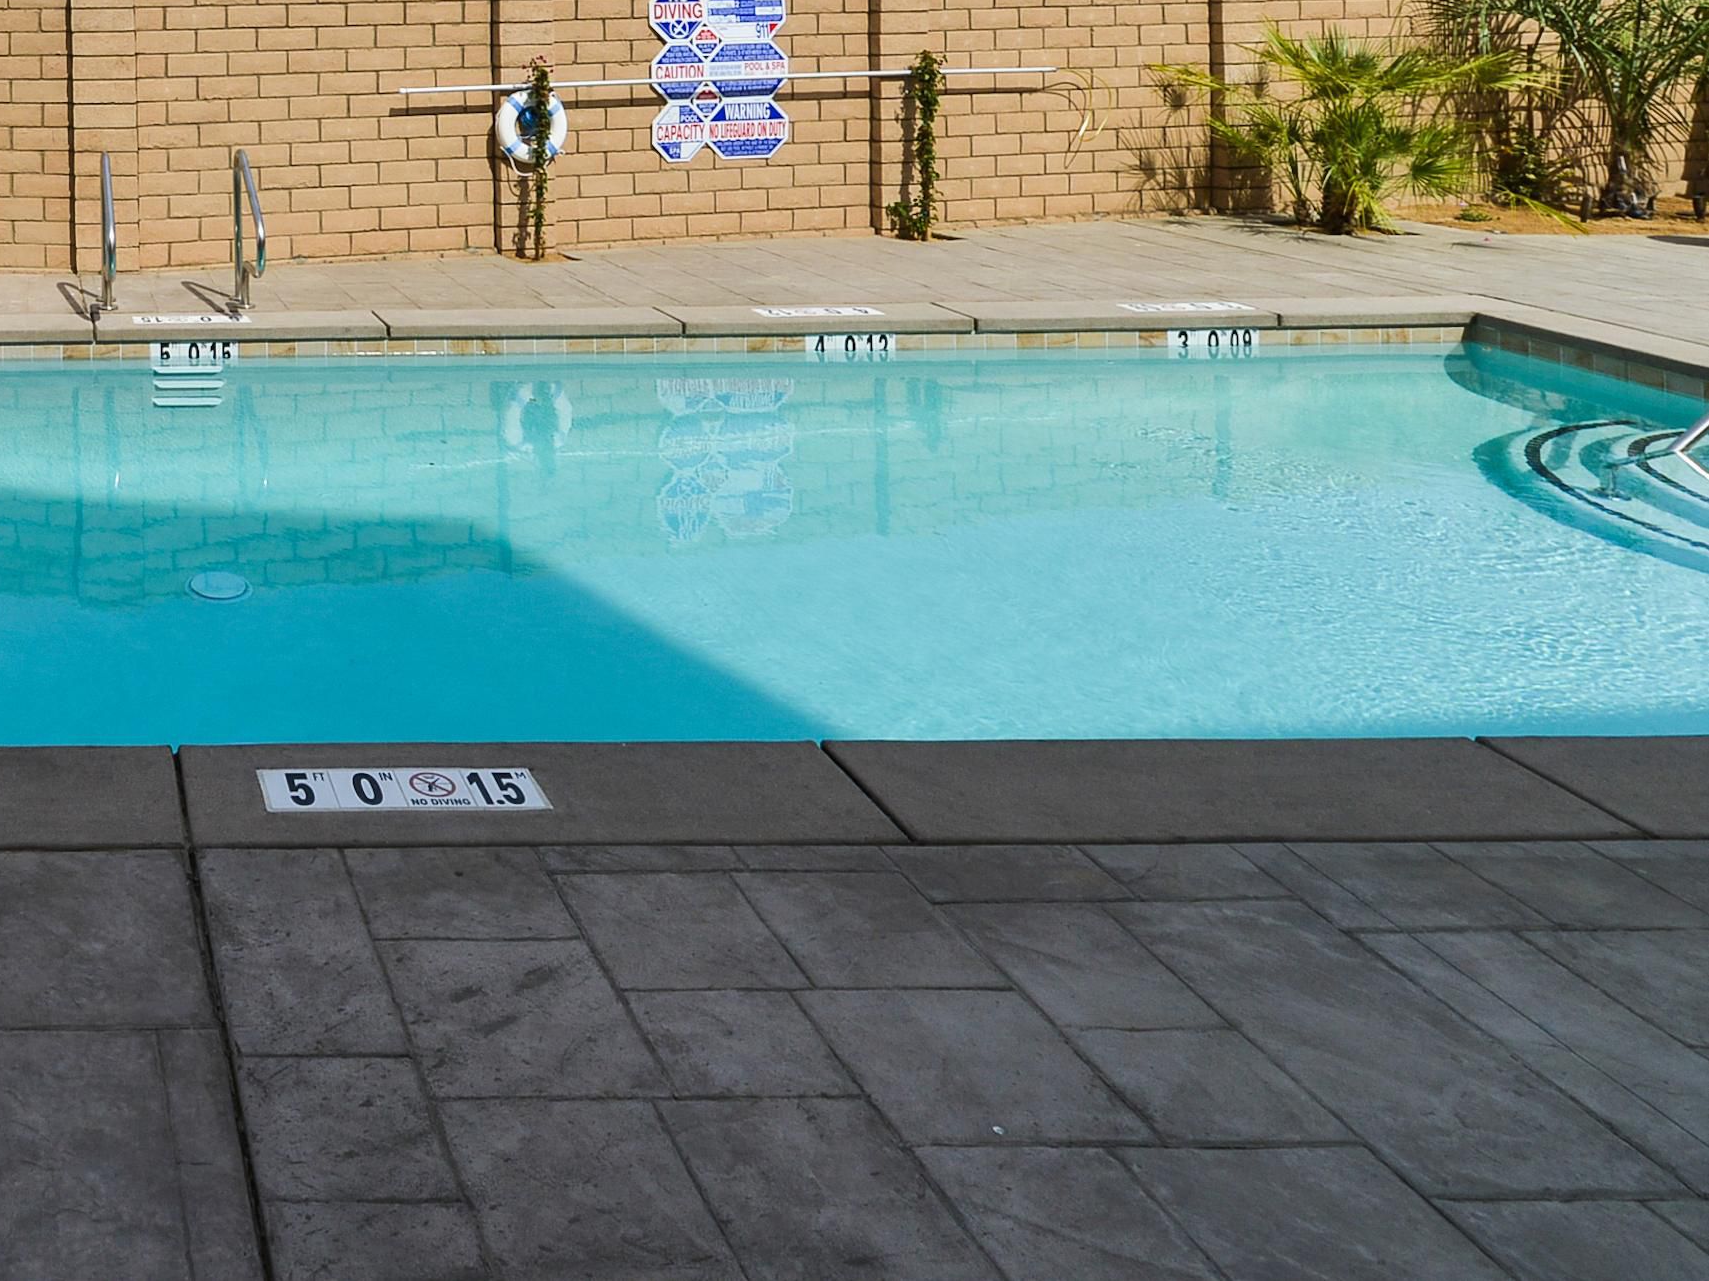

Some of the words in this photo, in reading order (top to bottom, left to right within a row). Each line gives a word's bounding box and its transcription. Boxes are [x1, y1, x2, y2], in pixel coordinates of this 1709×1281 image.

[654, 3, 703, 19] DIVING
[755, 23, 769, 39] 911
[656, 65, 704, 80] CAUTION
[744, 62, 764, 71] POOL
[771, 61, 785, 70] SPA
[724, 103, 771, 120] WARNING
[657, 124, 705, 141] CAPACITY
[709, 124, 719, 139] NO
[721, 123, 756, 139] LIFEGUARD
[757, 122, 767, 137] ON
[769, 121, 786, 137] DUTY
[814, 335, 825, 352] 4
[1178, 330, 1188, 348] 3
[160, 342, 171, 360] 5
[188, 342, 200, 360] 0
[284, 772, 316, 806] 5
[312, 772, 325, 782] FT
[351, 771, 384, 806] 0
[379, 771, 393, 781] IN
[466, 771, 527, 806] 1.5
[515, 771, 527, 780] M
[411, 798, 428, 806] NO
[430, 798, 471, 806] DIVING
